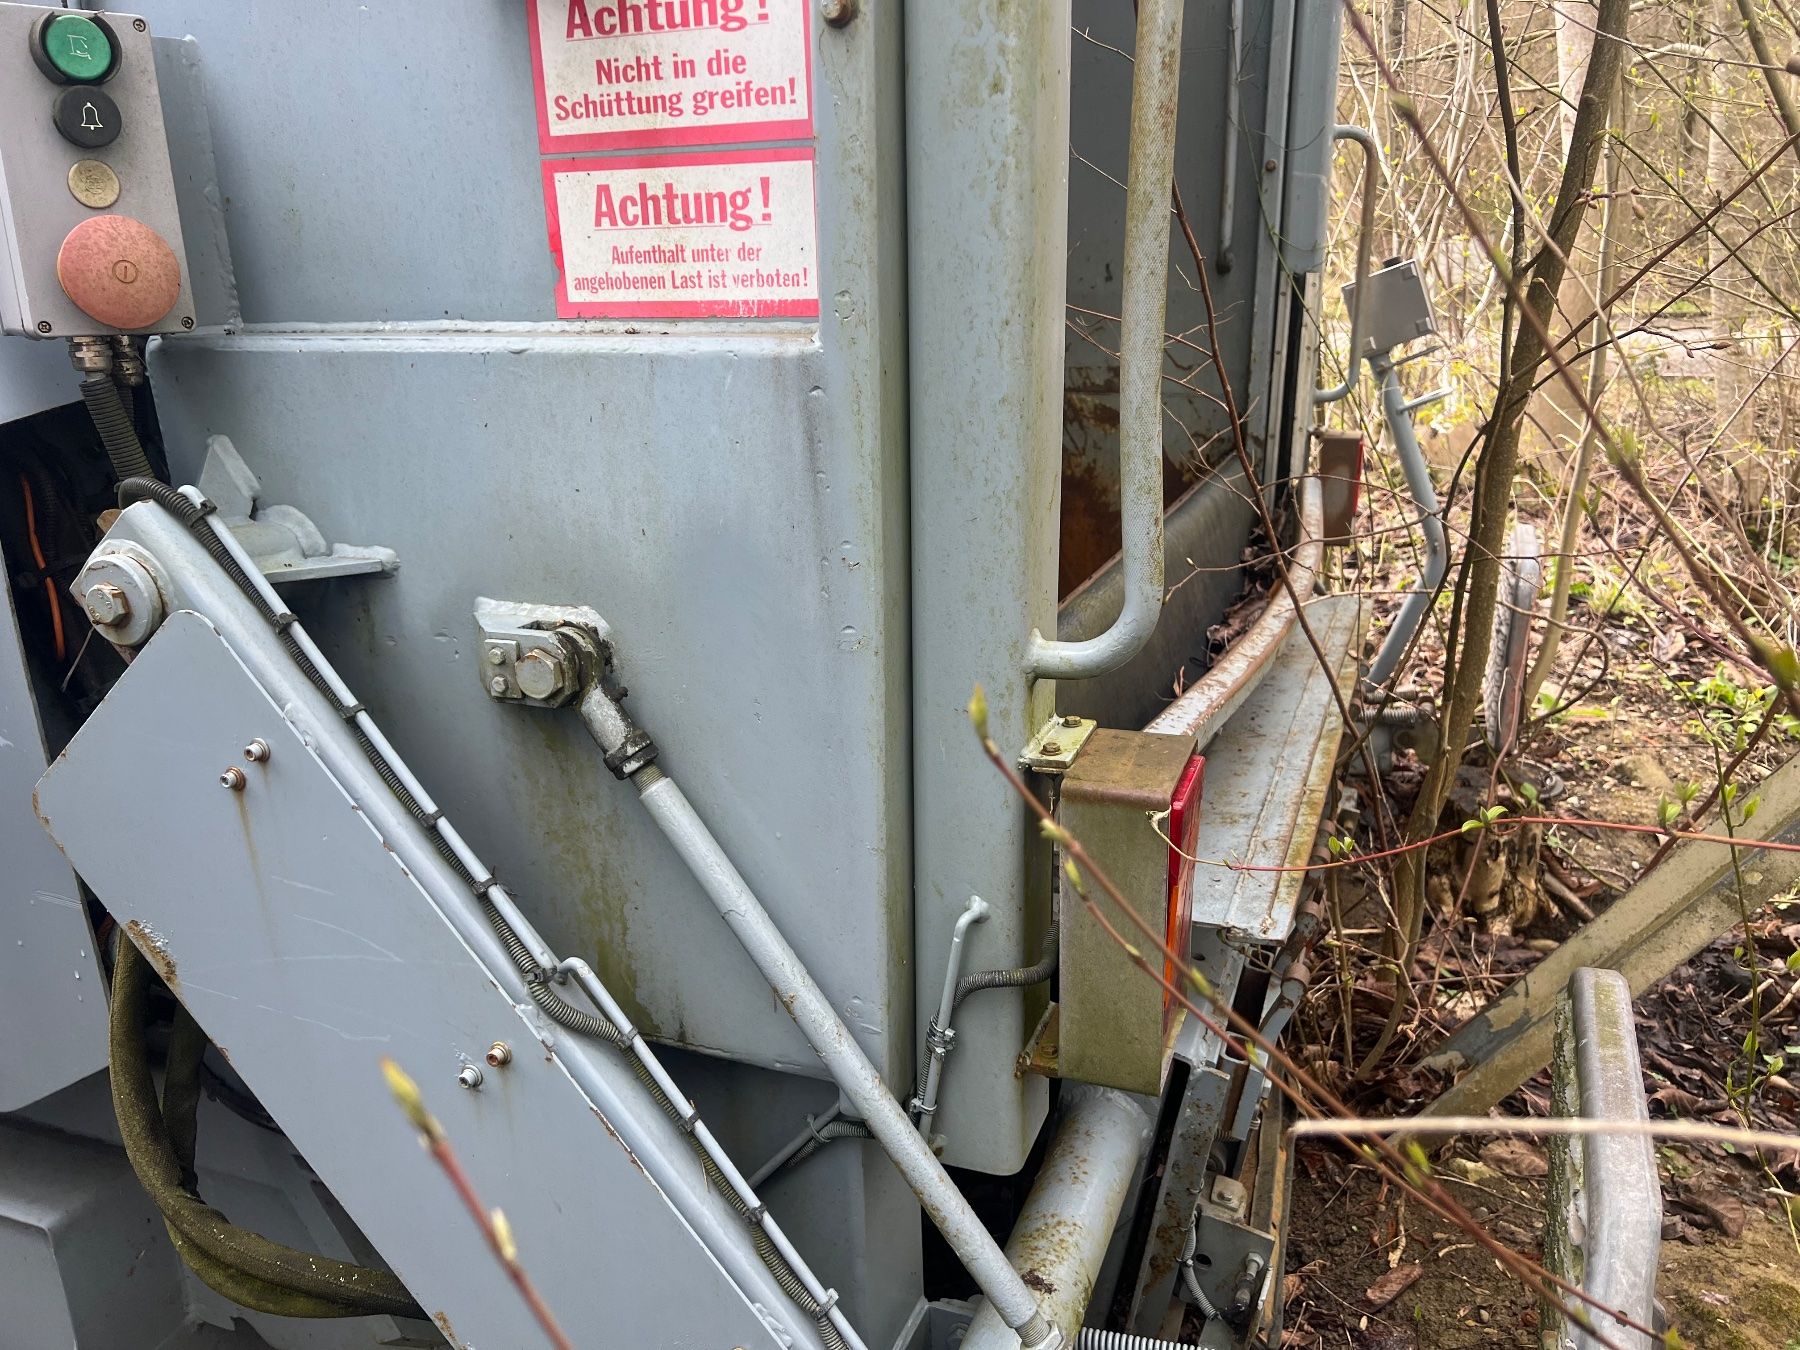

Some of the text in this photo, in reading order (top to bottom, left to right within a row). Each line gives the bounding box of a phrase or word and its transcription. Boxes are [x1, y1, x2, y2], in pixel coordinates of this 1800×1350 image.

[595, 48, 747, 85] Nicht in die
[554, 77, 796, 121] Schüttung greifen!
[611, 242, 763, 265] Aufenthalt unter der
[573, 267, 809, 294] angehobenen Last ist verboten!
